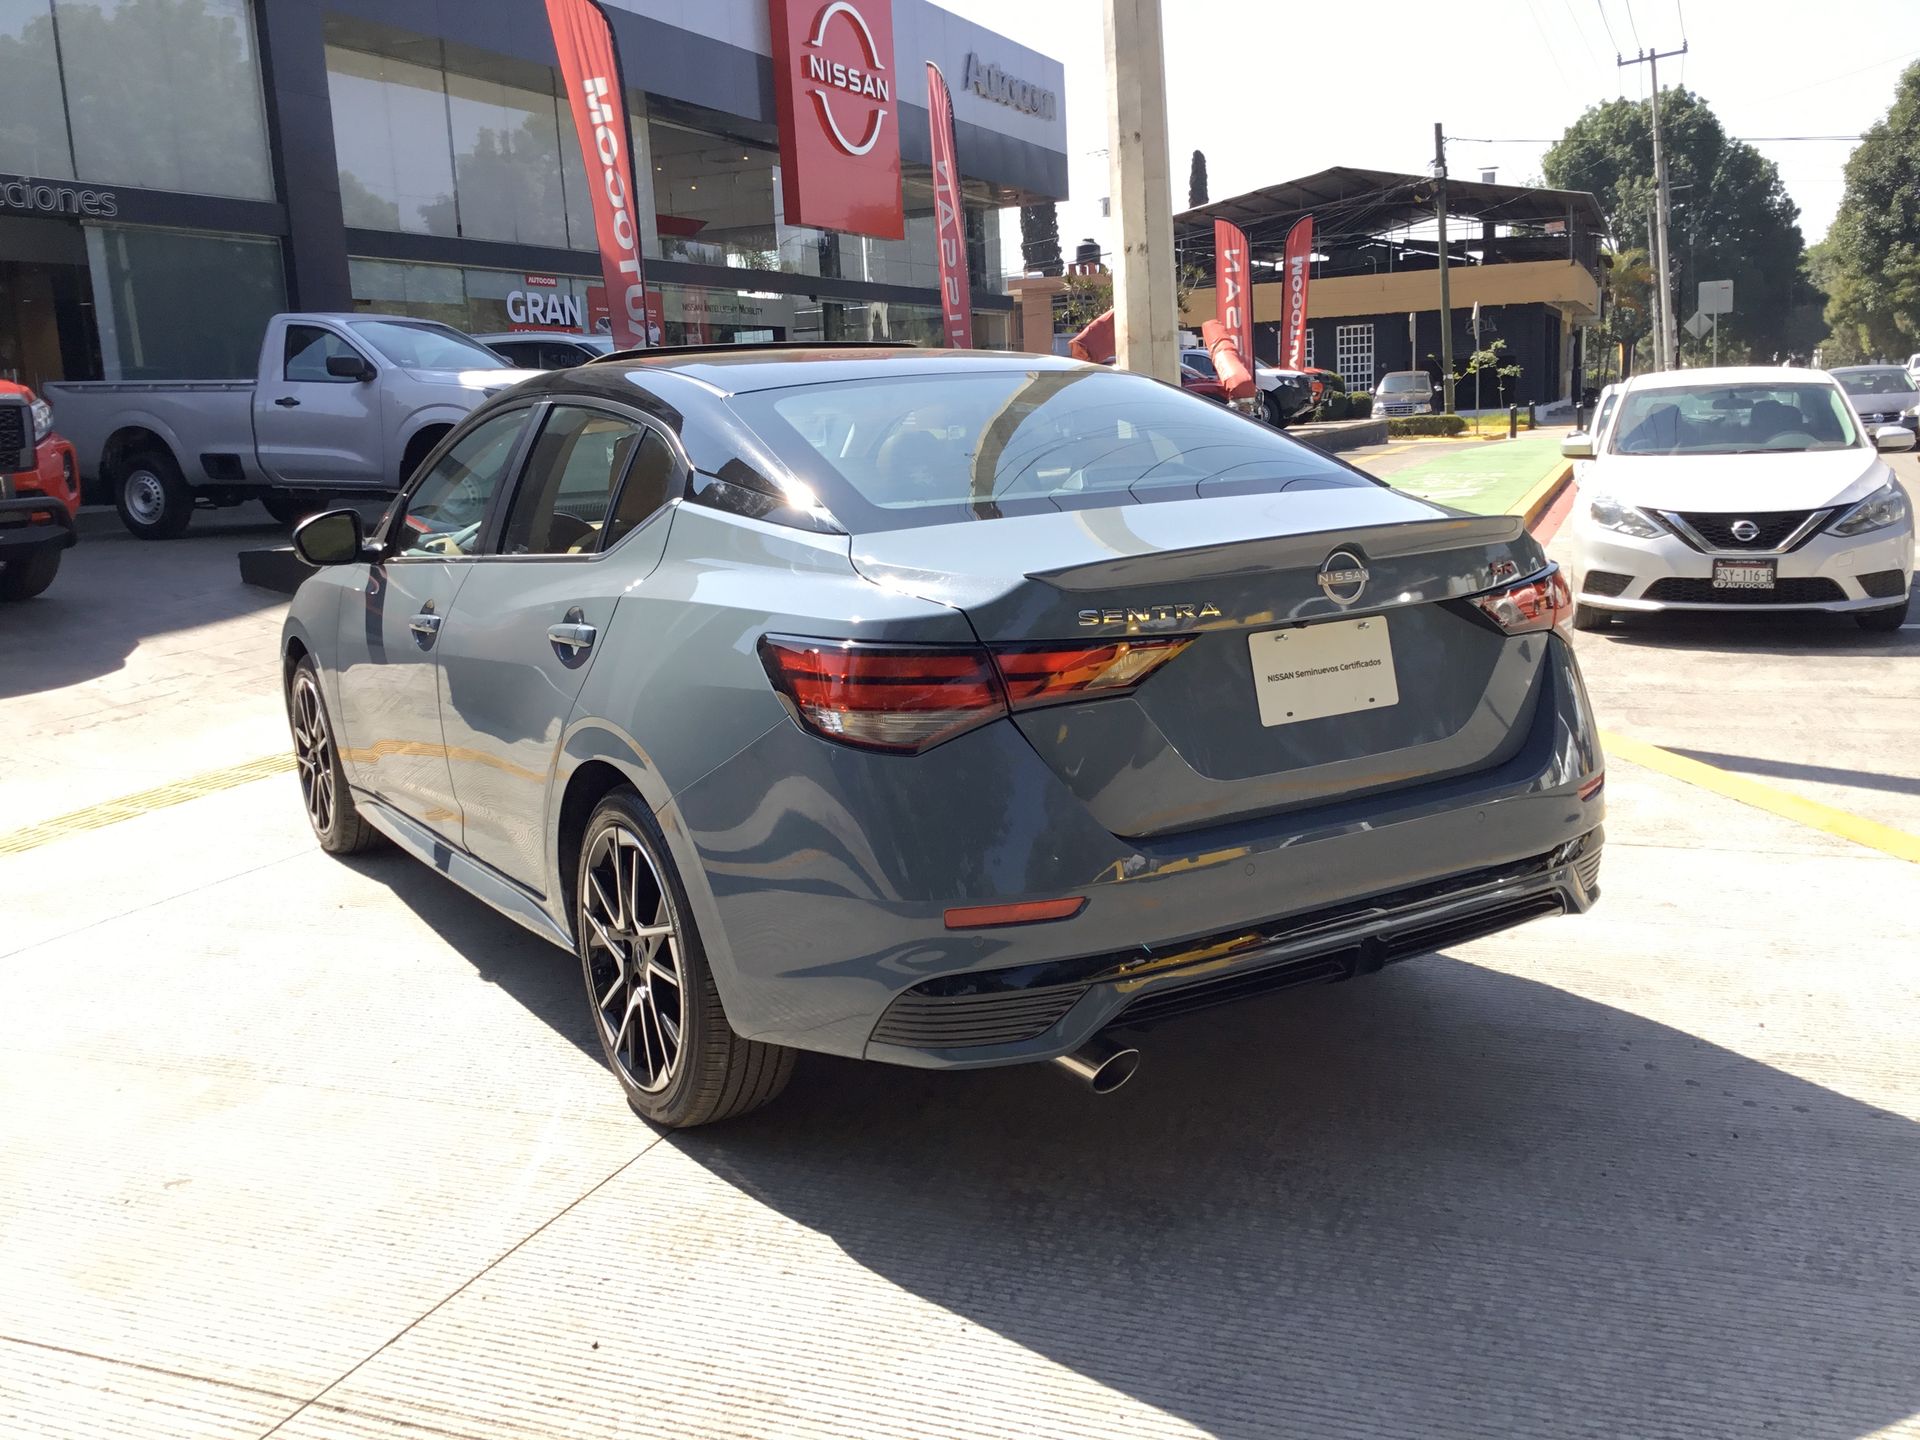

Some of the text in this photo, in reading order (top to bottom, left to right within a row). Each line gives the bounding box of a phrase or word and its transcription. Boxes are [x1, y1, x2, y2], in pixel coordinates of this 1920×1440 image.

[808, 54, 890, 102] NISSAN
[0, 177, 118, 217] ciones
[528, 276, 556, 286] AUTOCOM
[506, 290, 583, 326] GRAN
[1289, 256, 1303, 368] AUTOCOM
[1318, 568, 1370, 585] NISSAN
[1077, 600, 1222, 627] SENTRA
[1267, 658, 1382, 683] NISSAN Seminuevos Certificados
